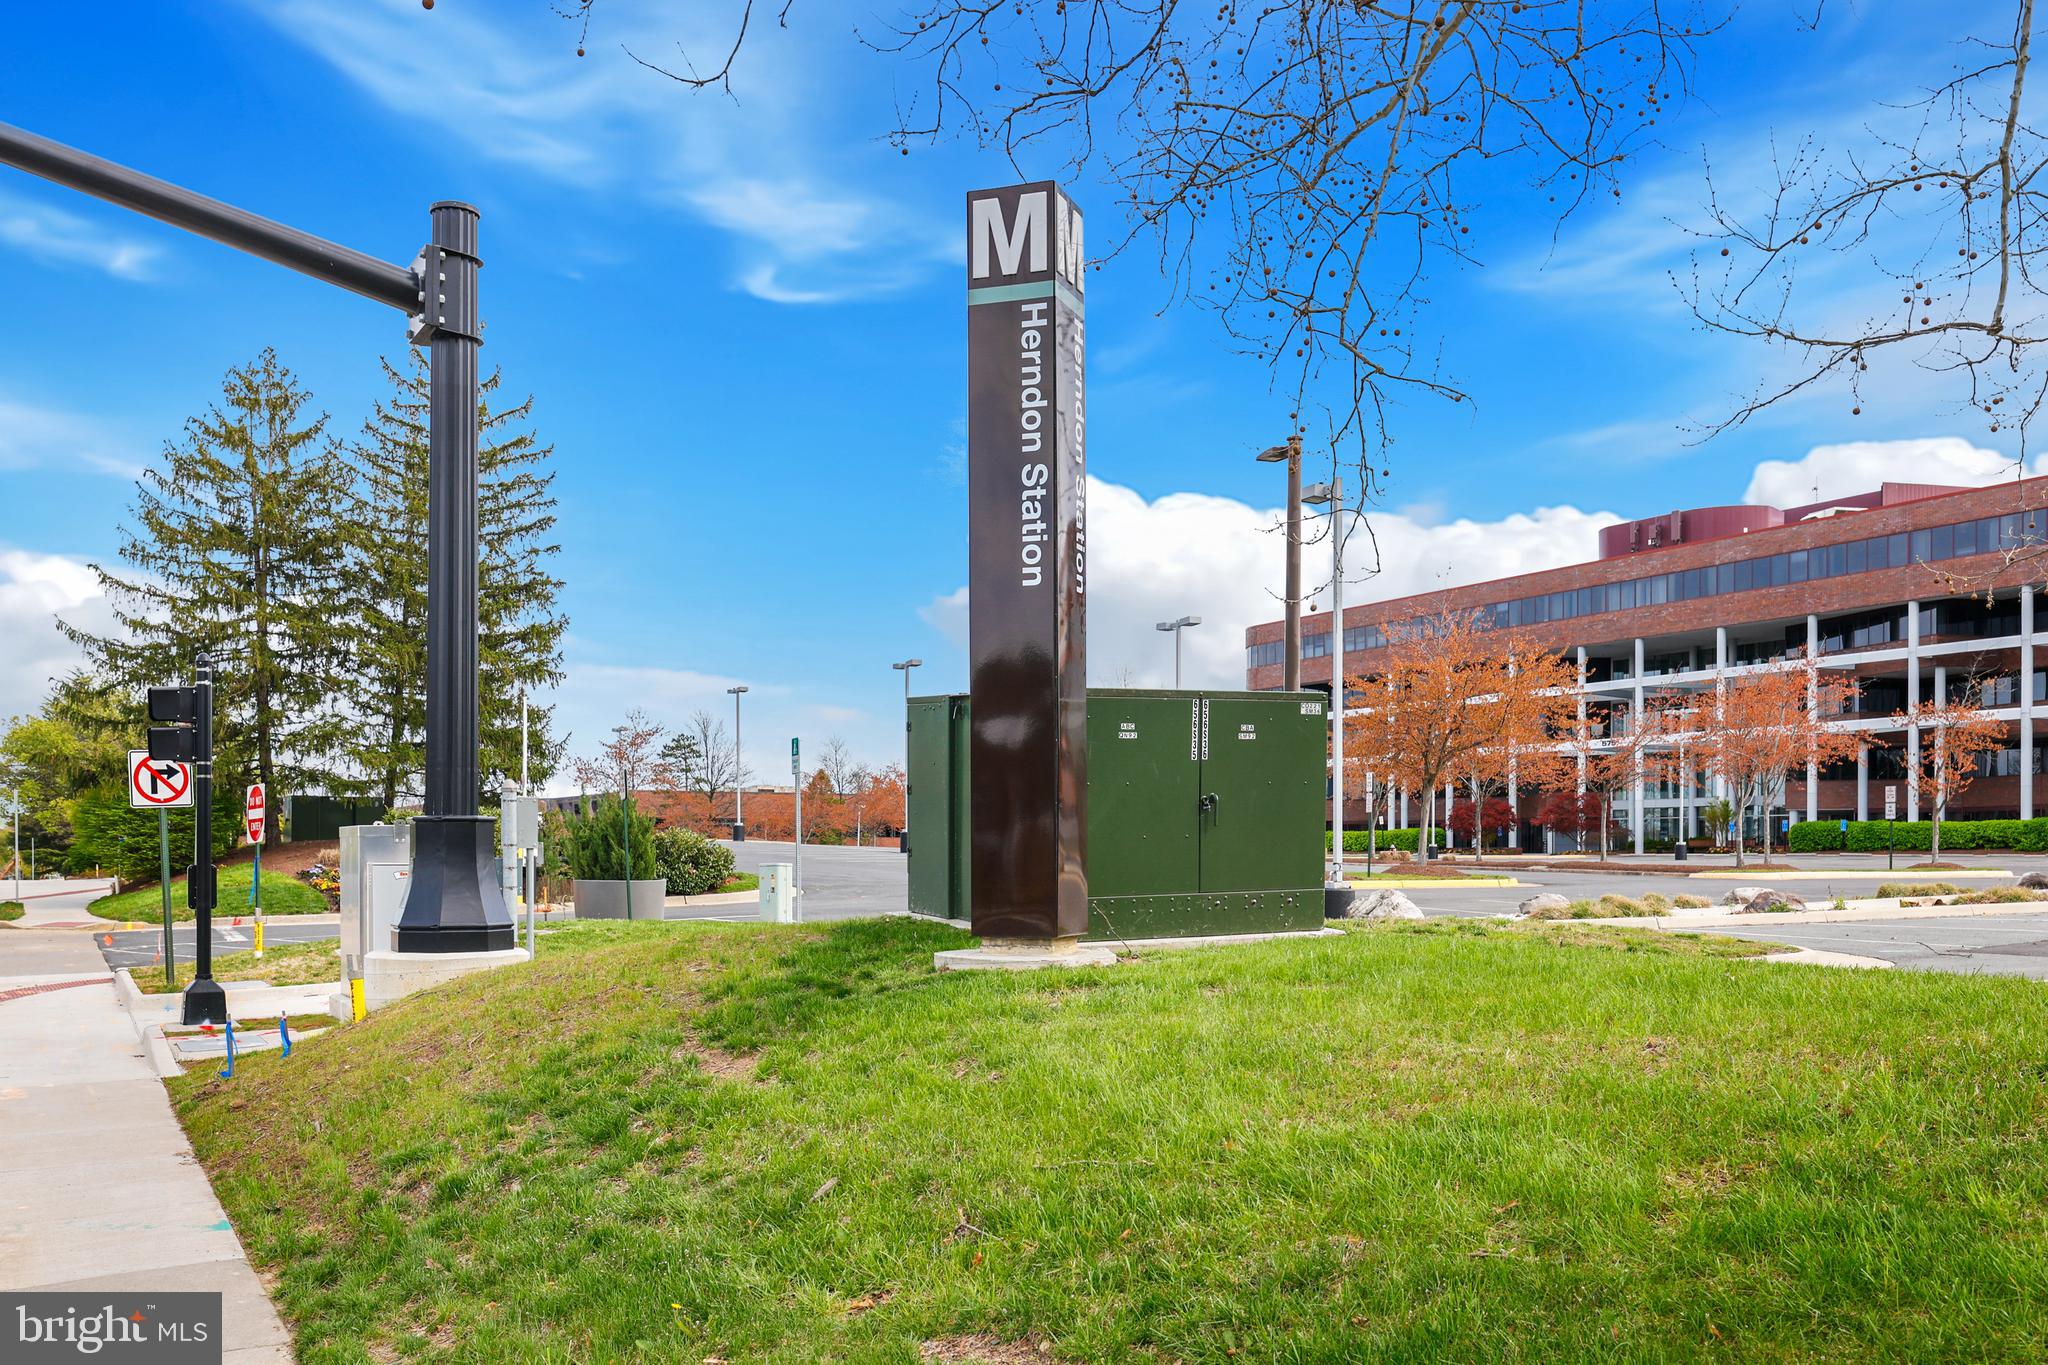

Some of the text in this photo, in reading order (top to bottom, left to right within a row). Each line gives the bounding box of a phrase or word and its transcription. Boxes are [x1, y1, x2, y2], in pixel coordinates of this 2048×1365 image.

[972, 191, 1048, 279] M
[1056, 192, 1085, 292] M
[1021, 302, 1048, 587] Herndon Station
[1074, 317, 1086, 594] Herndon Station
[255, 796, 263, 805] NOT
